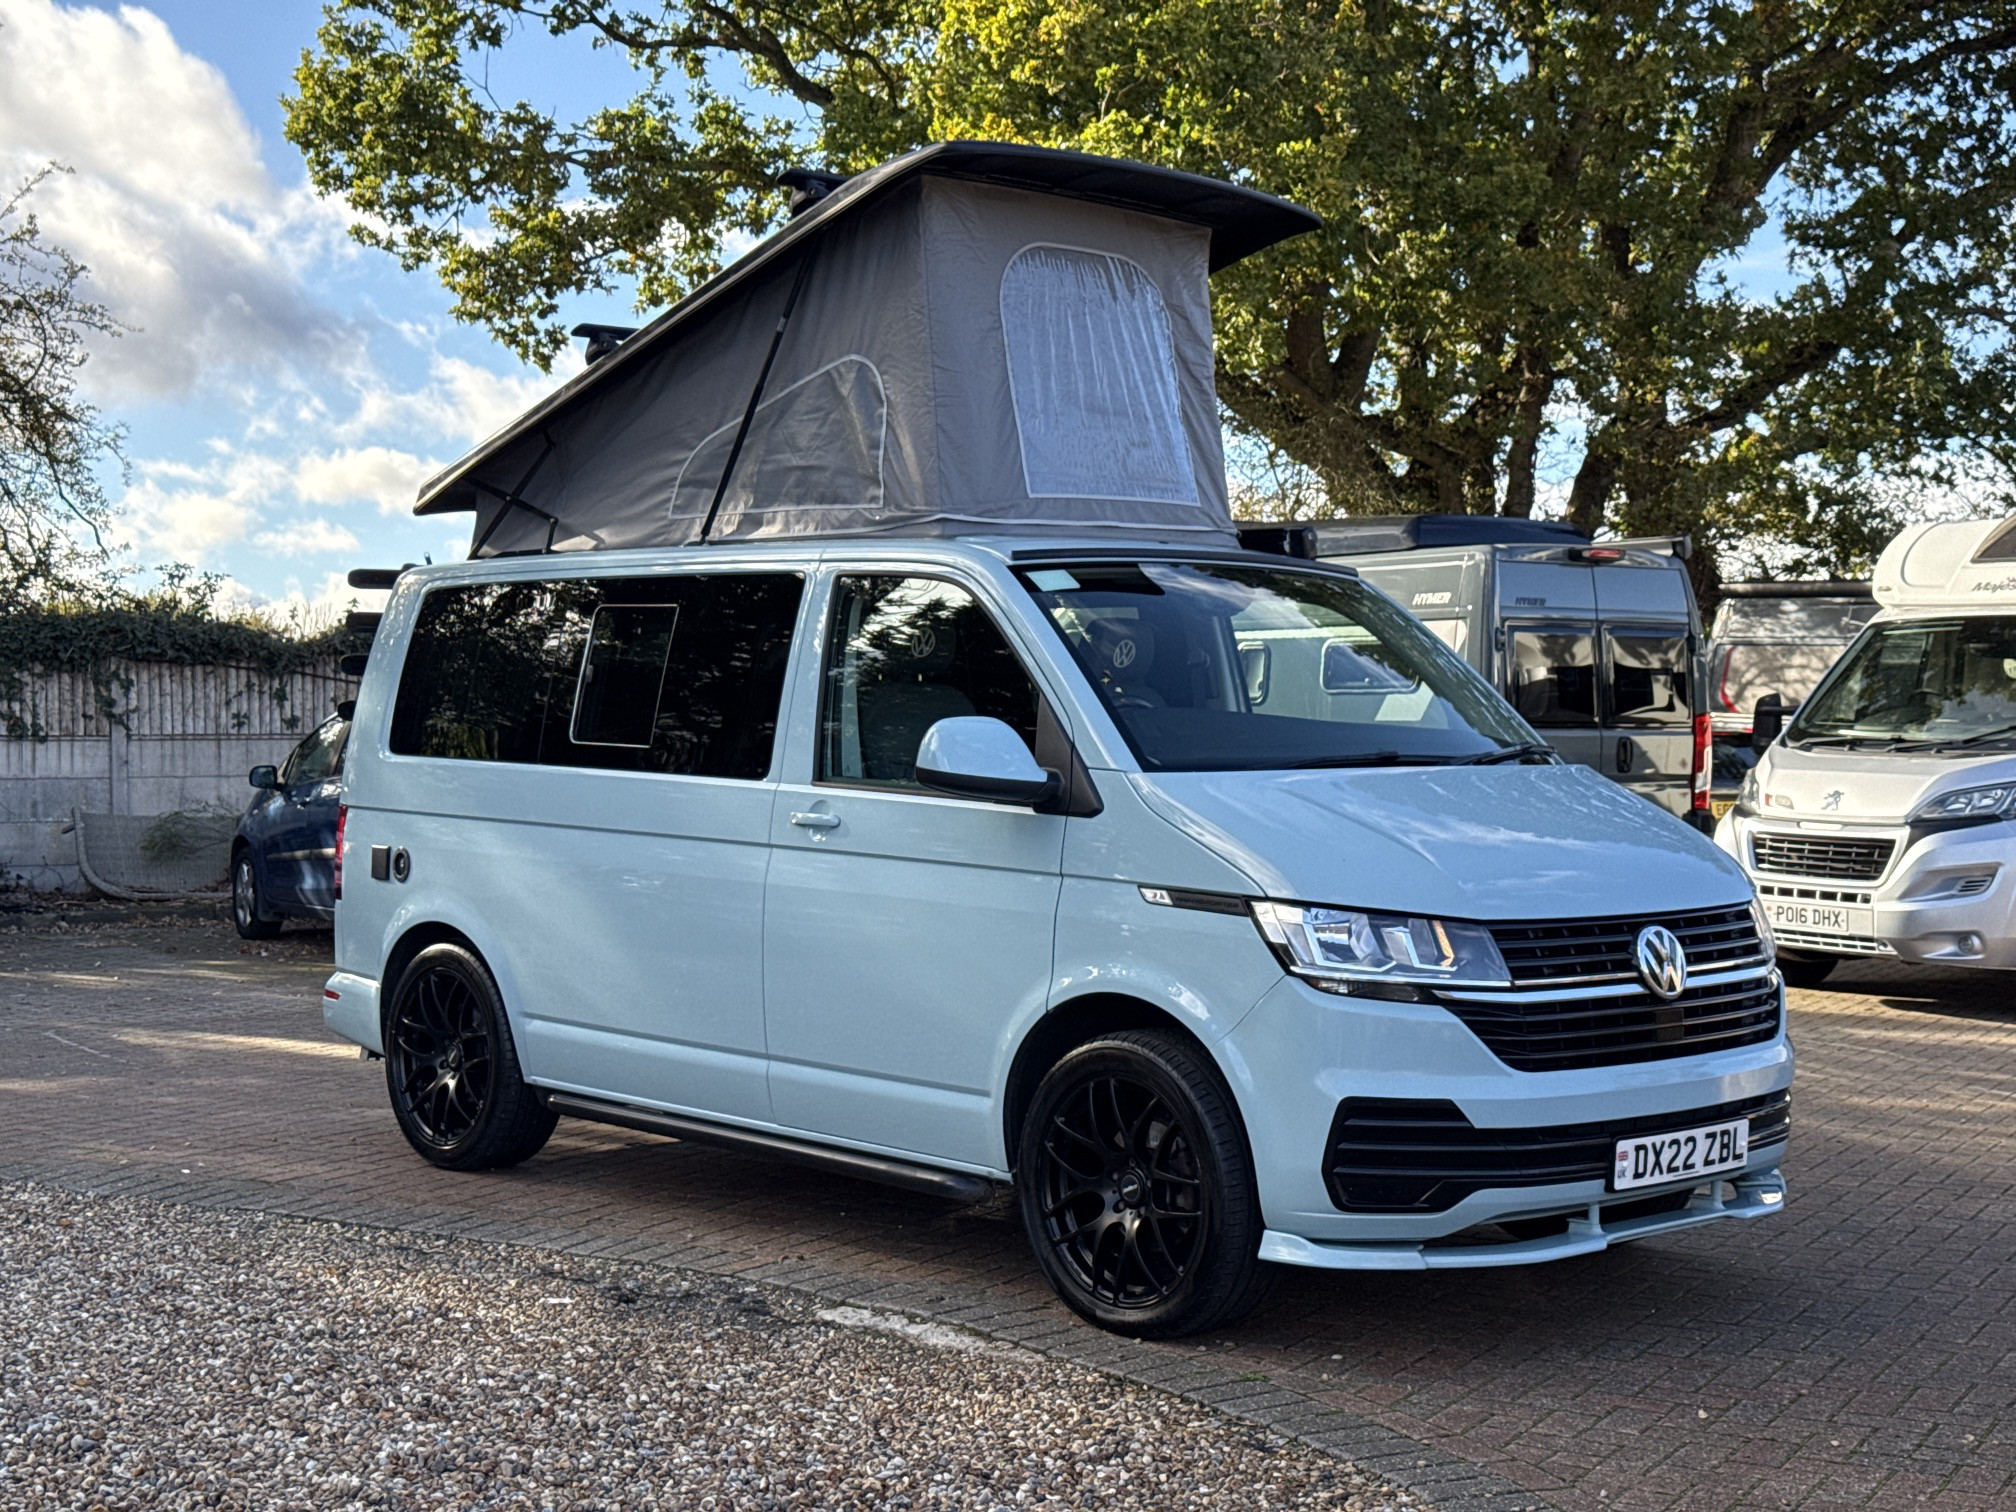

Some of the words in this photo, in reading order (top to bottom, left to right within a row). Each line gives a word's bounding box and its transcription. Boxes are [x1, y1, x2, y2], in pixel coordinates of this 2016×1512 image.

[1412, 591, 1452, 606] HYMER
[1812, 908, 1841, 928] DHX
[1632, 1135, 1697, 1180] DX22
[1702, 1127, 1744, 1167] ZBL
